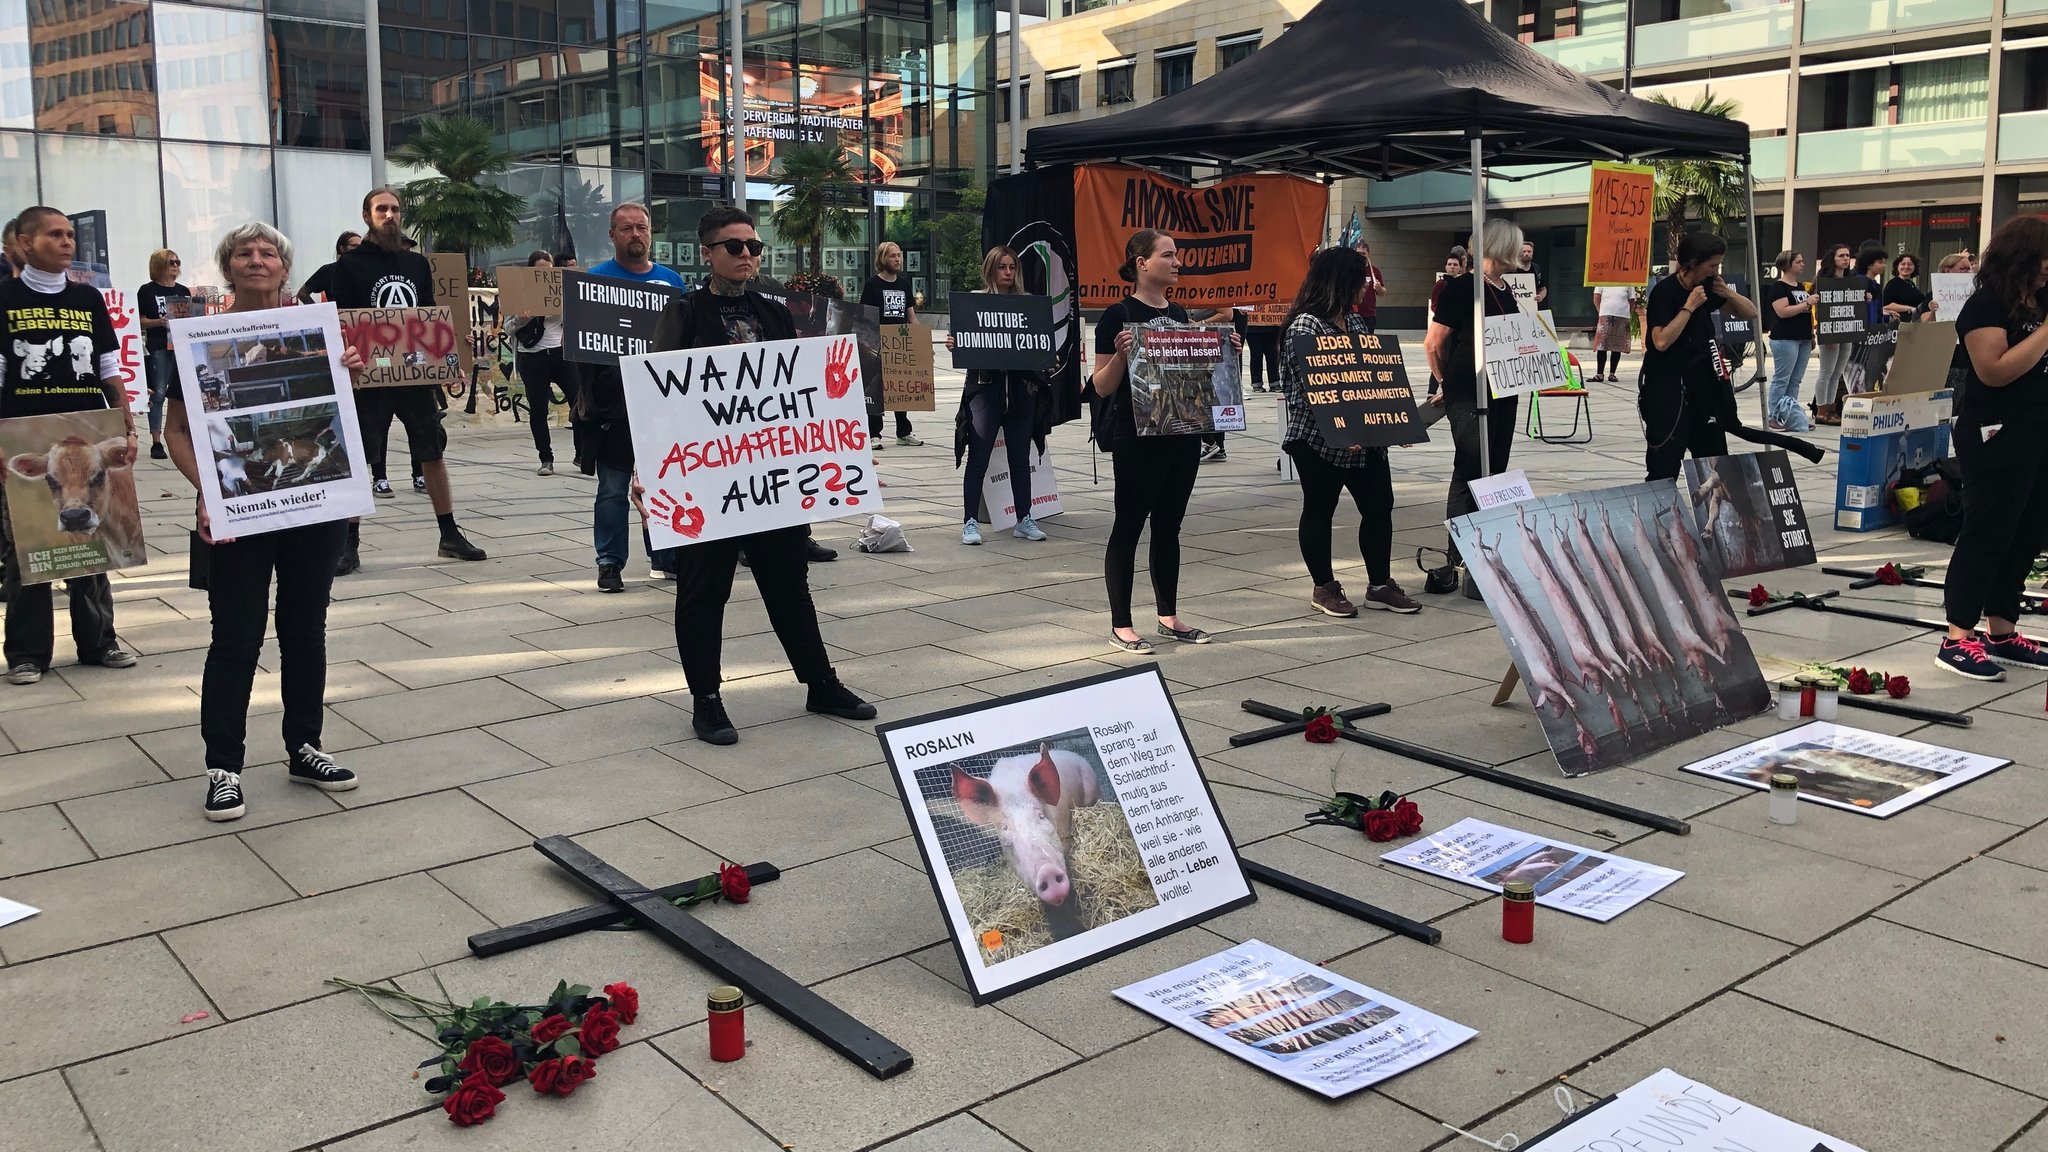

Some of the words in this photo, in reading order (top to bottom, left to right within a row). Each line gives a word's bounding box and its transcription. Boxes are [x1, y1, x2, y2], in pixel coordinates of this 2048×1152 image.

[807, 131, 824, 142] E.V.
[1121, 178, 1209, 233] ANIMAL
[1203, 185, 1256, 233] SAVE
[1596, 177, 1650, 217] 115.255
[371, 276, 388, 306] SUPPORT
[1512, 277, 1527, 290] du
[885, 296, 905, 305] CAGE
[1820, 291, 1833, 303] TIERE
[1833, 291, 1845, 302] SIND
[7, 308, 56, 322] TIERE
[416, 310, 450, 322] DEN
[976, 311, 1028, 329] YOUTUBE:
[188, 327, 229, 339] Schlachthof
[231, 322, 280, 334] Aschaffenburg
[1532, 320, 1547, 340] die
[1725, 321, 1750, 332] STIRBT.
[1820, 322, 1833, 334] KEINE
[578, 331, 624, 356] LEGALE
[892, 337, 914, 352] DIE
[956, 332, 1012, 348] DOMINION
[1015, 333, 1051, 352] (2018)
[1316, 336, 1353, 351] JEDER
[1358, 335, 1382, 350] DER
[370, 346, 395, 360] AN
[882, 352, 916, 367] TIERE
[1148, 346, 1161, 358] sie
[1163, 346, 1189, 358] leiden
[1191, 346, 1221, 358] lassen!
[1305, 353, 1357, 367] TIERISCHE
[1362, 354, 1403, 365] PRODUKTE
[644, 345, 800, 398] WANN
[1307, 371, 1374, 386] KONSUMIERT
[1377, 371, 1394, 382] GIBT
[1487, 351, 1569, 389] FOLTERKAMMER
[1307, 389, 1340, 405] DIESE
[1341, 388, 1411, 402] GRAUSAMKEITEN
[702, 386, 818, 426] WACHT
[1333, 416, 1346, 429] IN
[1364, 411, 1410, 425] AUFTRAG
[1873, 412, 1904, 430] PHILIPS
[658, 418, 868, 479] ASCHAFFENBURG
[990, 472, 1010, 484] NICHT
[1771, 467, 1784, 484] DU
[225, 498, 277, 516] Niemals
[280, 489, 327, 507] wieder!
[1479, 486, 1526, 508] TIERFREUNDE
[1769, 487, 1799, 506] KAUFST,
[1782, 509, 1797, 526] SIE
[1781, 529, 1810, 548] STIRBT.
[28, 550, 51, 563] ICH
[53, 546, 68, 554] KEIN
[69, 544, 90, 553] STEAK,
[30, 561, 53, 574] BIN
[54, 554, 73, 563] KEINE
[1092, 720, 1135, 739] Rosalyn
[904, 731, 975, 760] ROSALYN
[1100, 737, 1137, 754] sprang
[1142, 729, 1159, 743] auf
[1107, 756, 1128, 770] dem
[1129, 749, 1155, 766] Weg
[1156, 743, 1176, 757] zum
[1113, 761, 1169, 786] Schlachthof
[1121, 784, 1149, 802] mutig
[1150, 781, 1168, 794] aus
[1128, 803, 1150, 818] dem
[1151, 795, 1184, 813] fahren-
[1134, 820, 1155, 835] den
[1155, 806, 1203, 829] Anhänger,
[1140, 834, 1162, 851] weil
[1162, 830, 1178, 844] sie
[1184, 823, 1202, 837] wie
[1147, 853, 1166, 869] alle
[1167, 840, 1208, 861] anderen
[1154, 867, 1179, 885] auch
[1186, 855, 1220, 874] Leben
[1160, 881, 1193, 902] wollte!
[1145, 986, 1172, 999] Wie
[1173, 970, 1220, 990] müssen
[1219, 964, 1238, 974] sie
[1237, 959, 1251, 968] in
[1160, 989, 1199, 1006] dieser
[1333, 1043, 1365, 1060] mehr
[1364, 1024, 1409, 1047] wieder!
